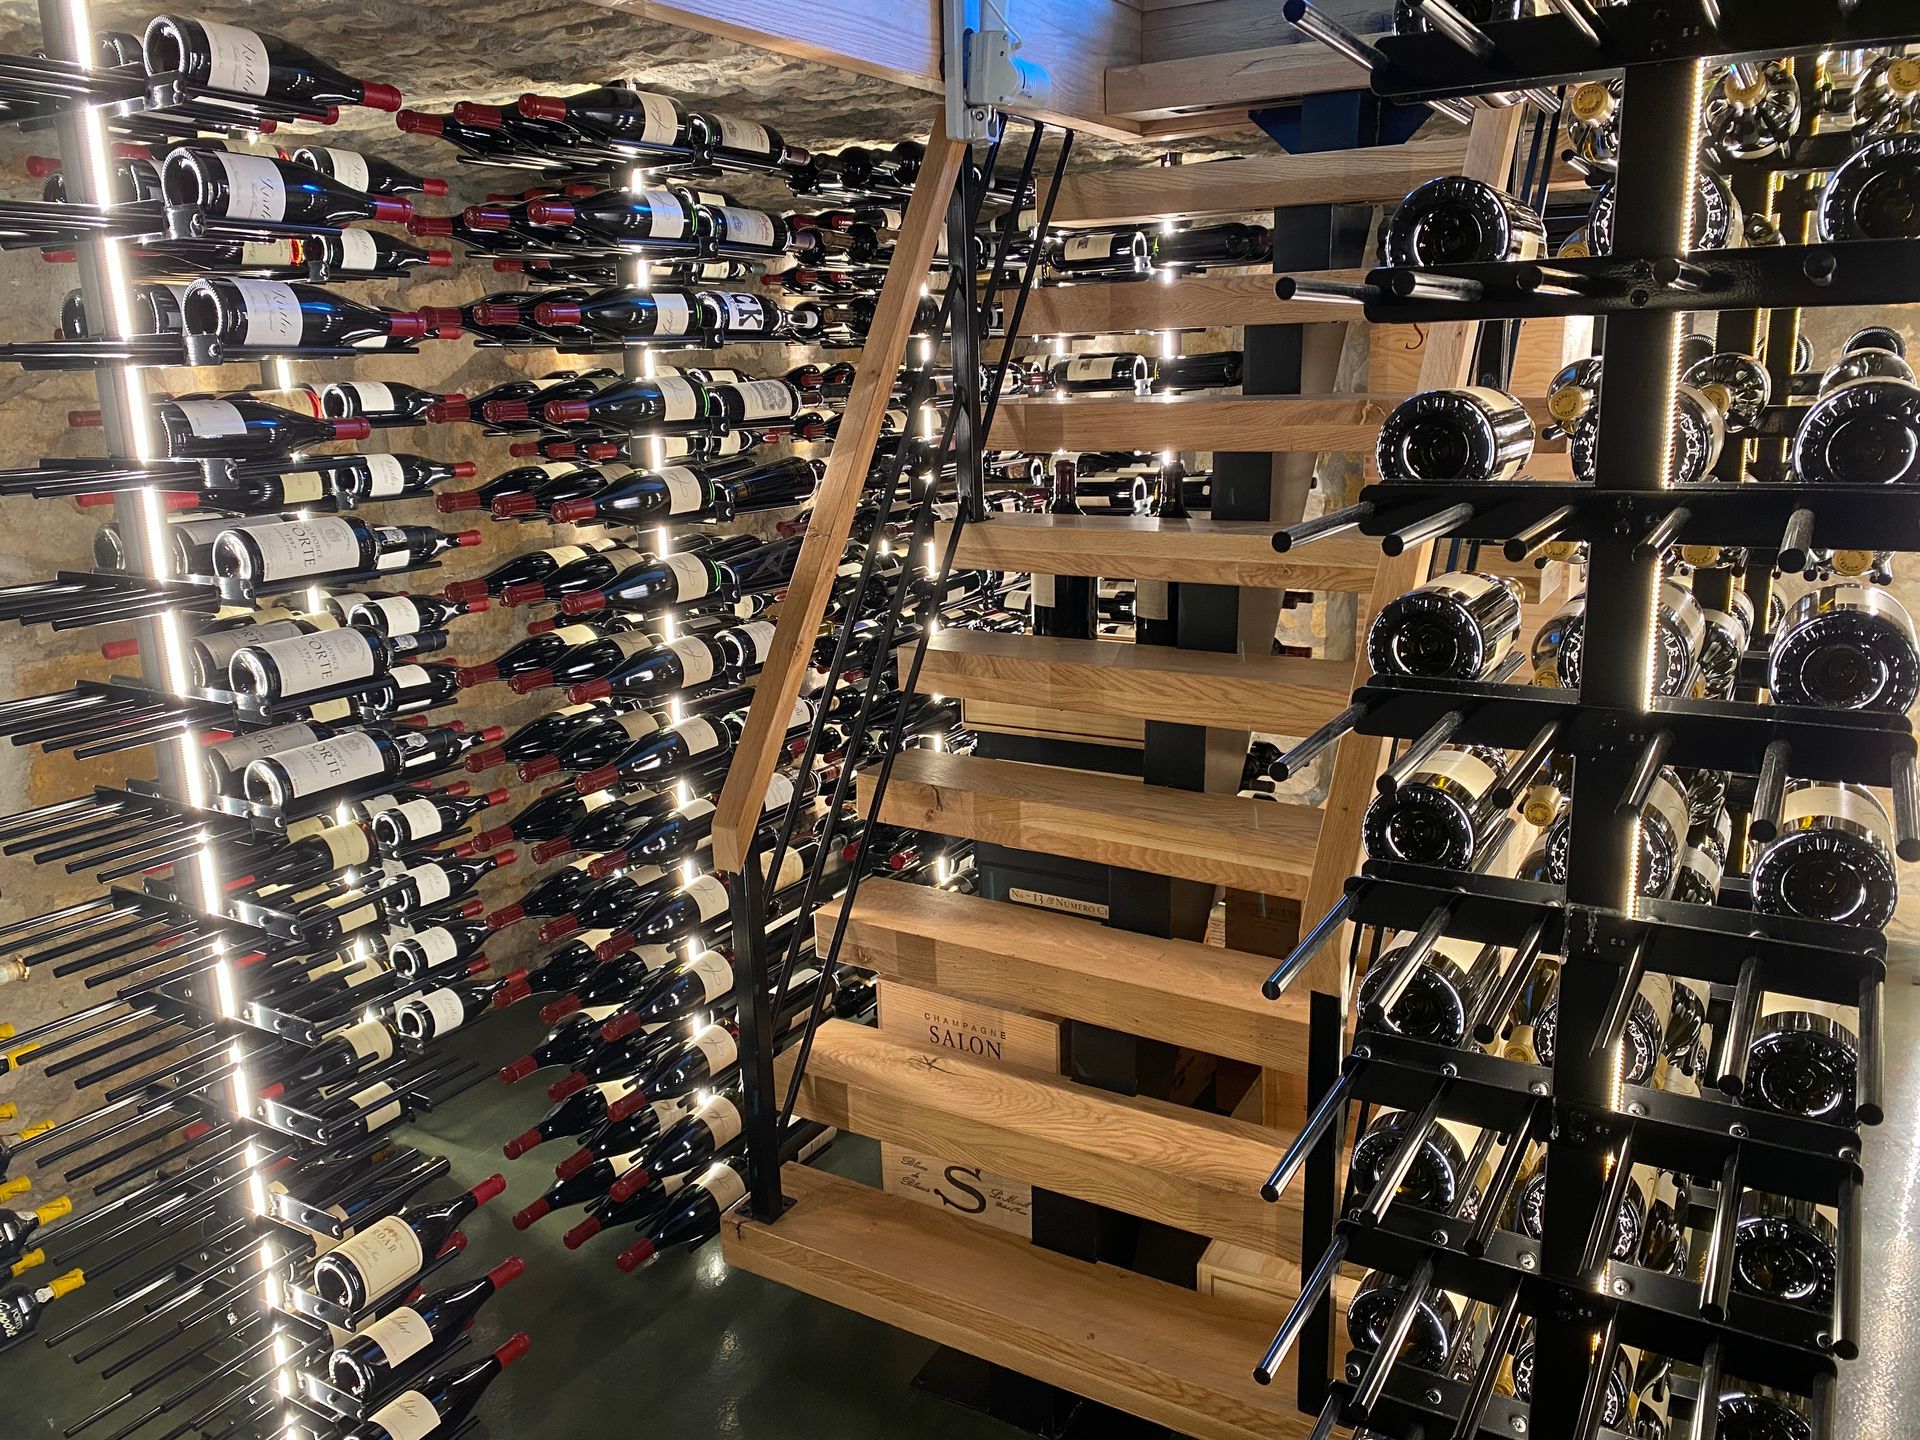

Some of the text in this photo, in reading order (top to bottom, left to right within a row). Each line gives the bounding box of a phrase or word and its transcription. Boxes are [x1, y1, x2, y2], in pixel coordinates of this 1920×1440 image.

[258, 176, 275, 219] Kistle
[312, 742, 342, 779] ORTE
[924, 1012, 1007, 1040] CHAMPAGNE
[929, 1025, 1002, 1060] SALON
[933, 1165, 987, 1214] S
[370, 1228, 398, 1254] ROAR
[11, 1307, 24, 1330] PORTO
